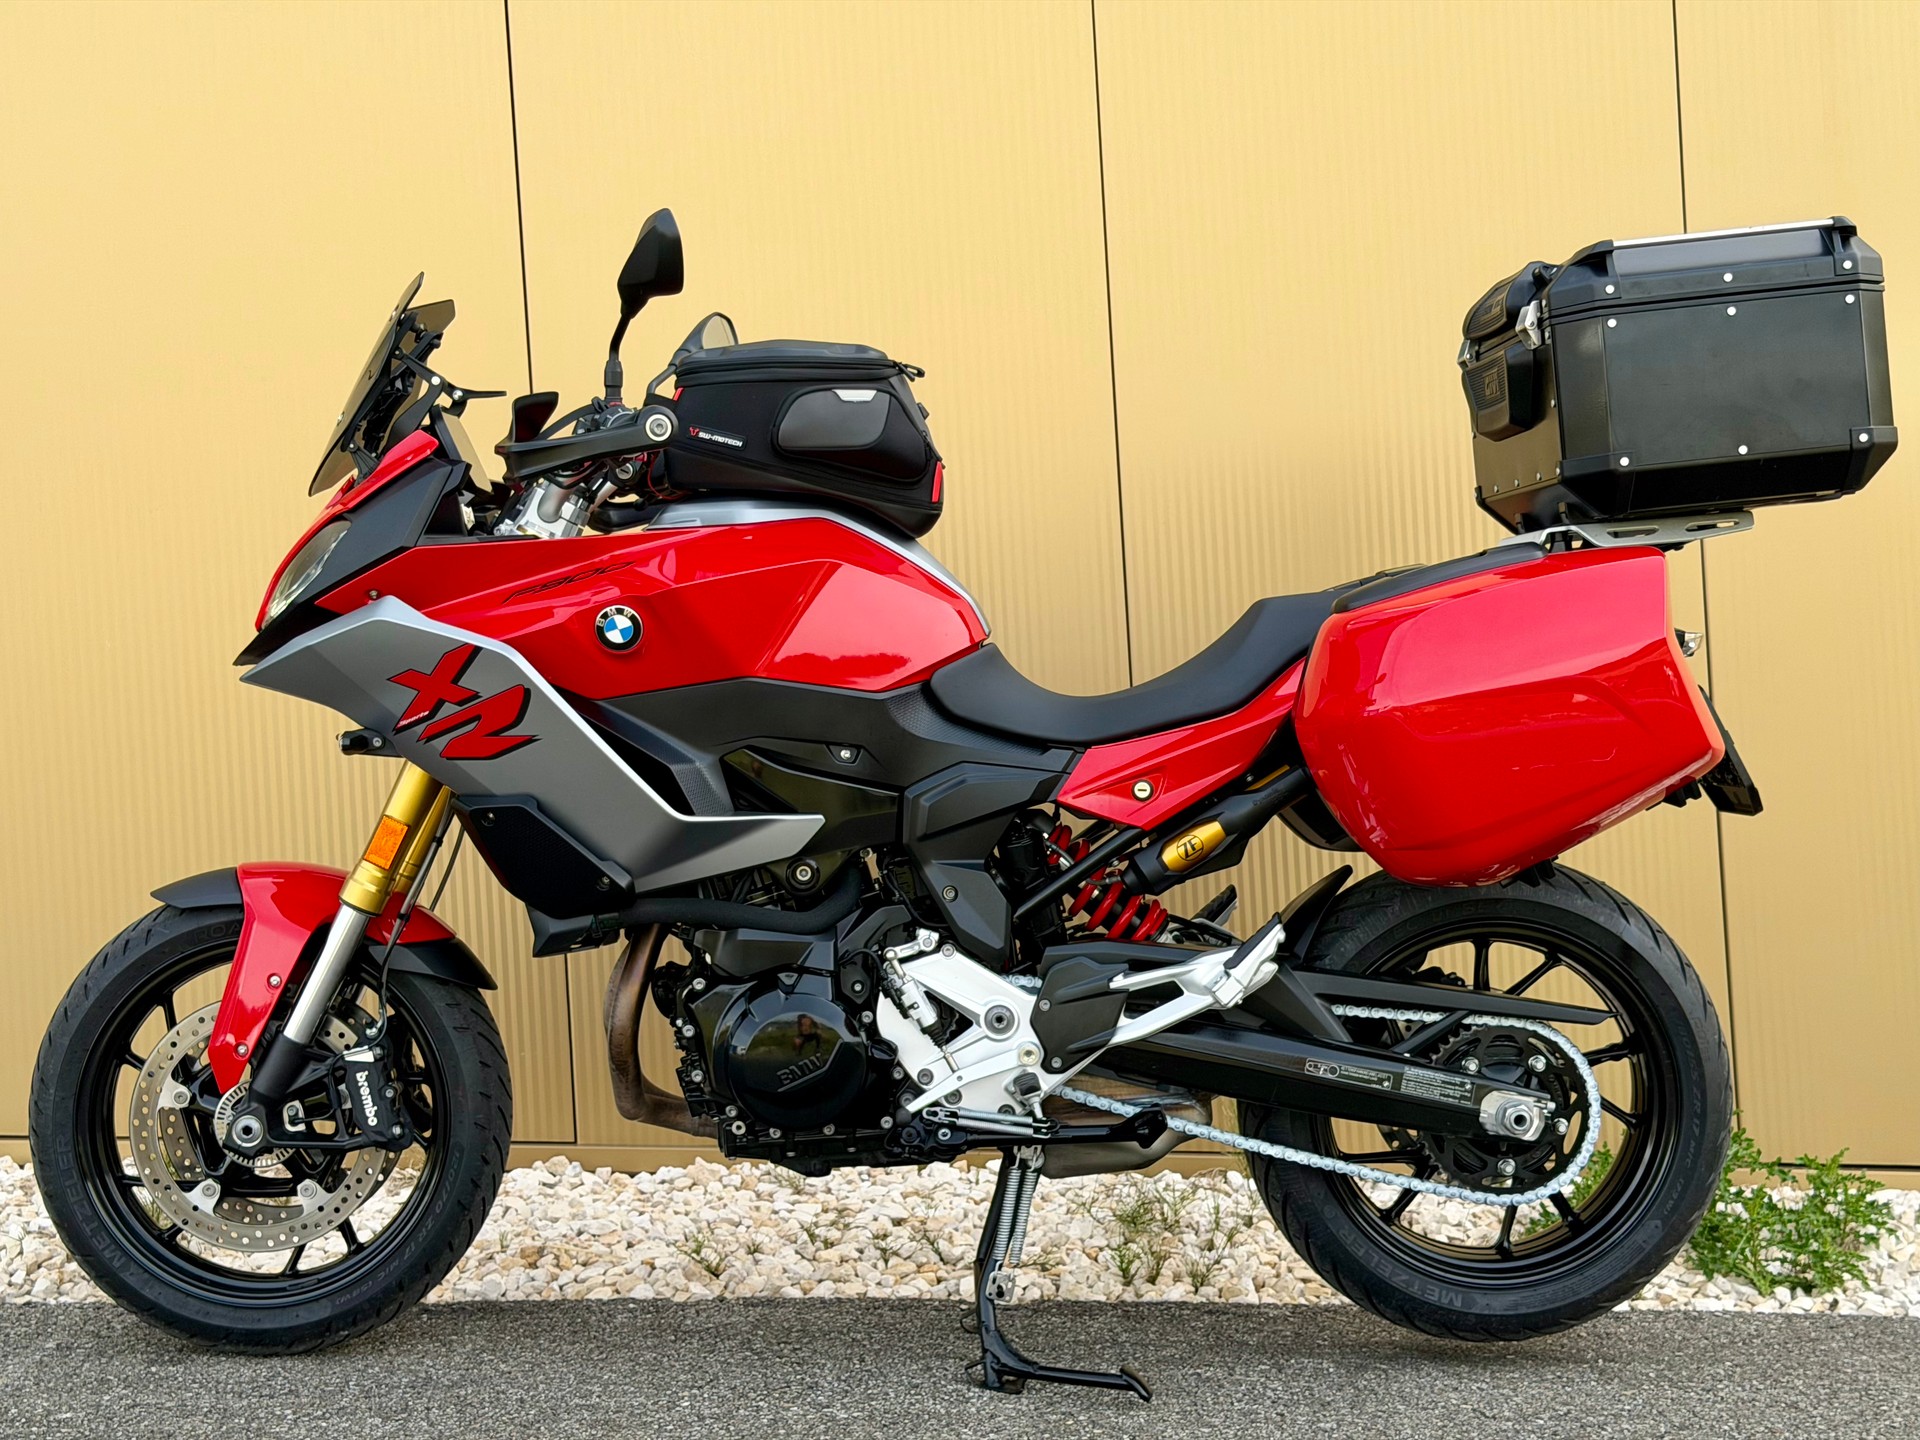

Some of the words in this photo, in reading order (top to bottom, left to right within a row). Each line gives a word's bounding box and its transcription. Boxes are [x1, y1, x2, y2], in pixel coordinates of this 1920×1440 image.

[698, 431, 743, 447] SW-MOTECH
[596, 607, 633, 629] BMW
[1178, 836, 1203, 860] ZF
[355, 1070, 378, 1126] brembo
[1692, 1117, 1702, 1137] 17
[56, 1134, 127, 1270] METZELER
[403, 1242, 417, 1261] 17
[1338, 1224, 1463, 1308] METZELER
